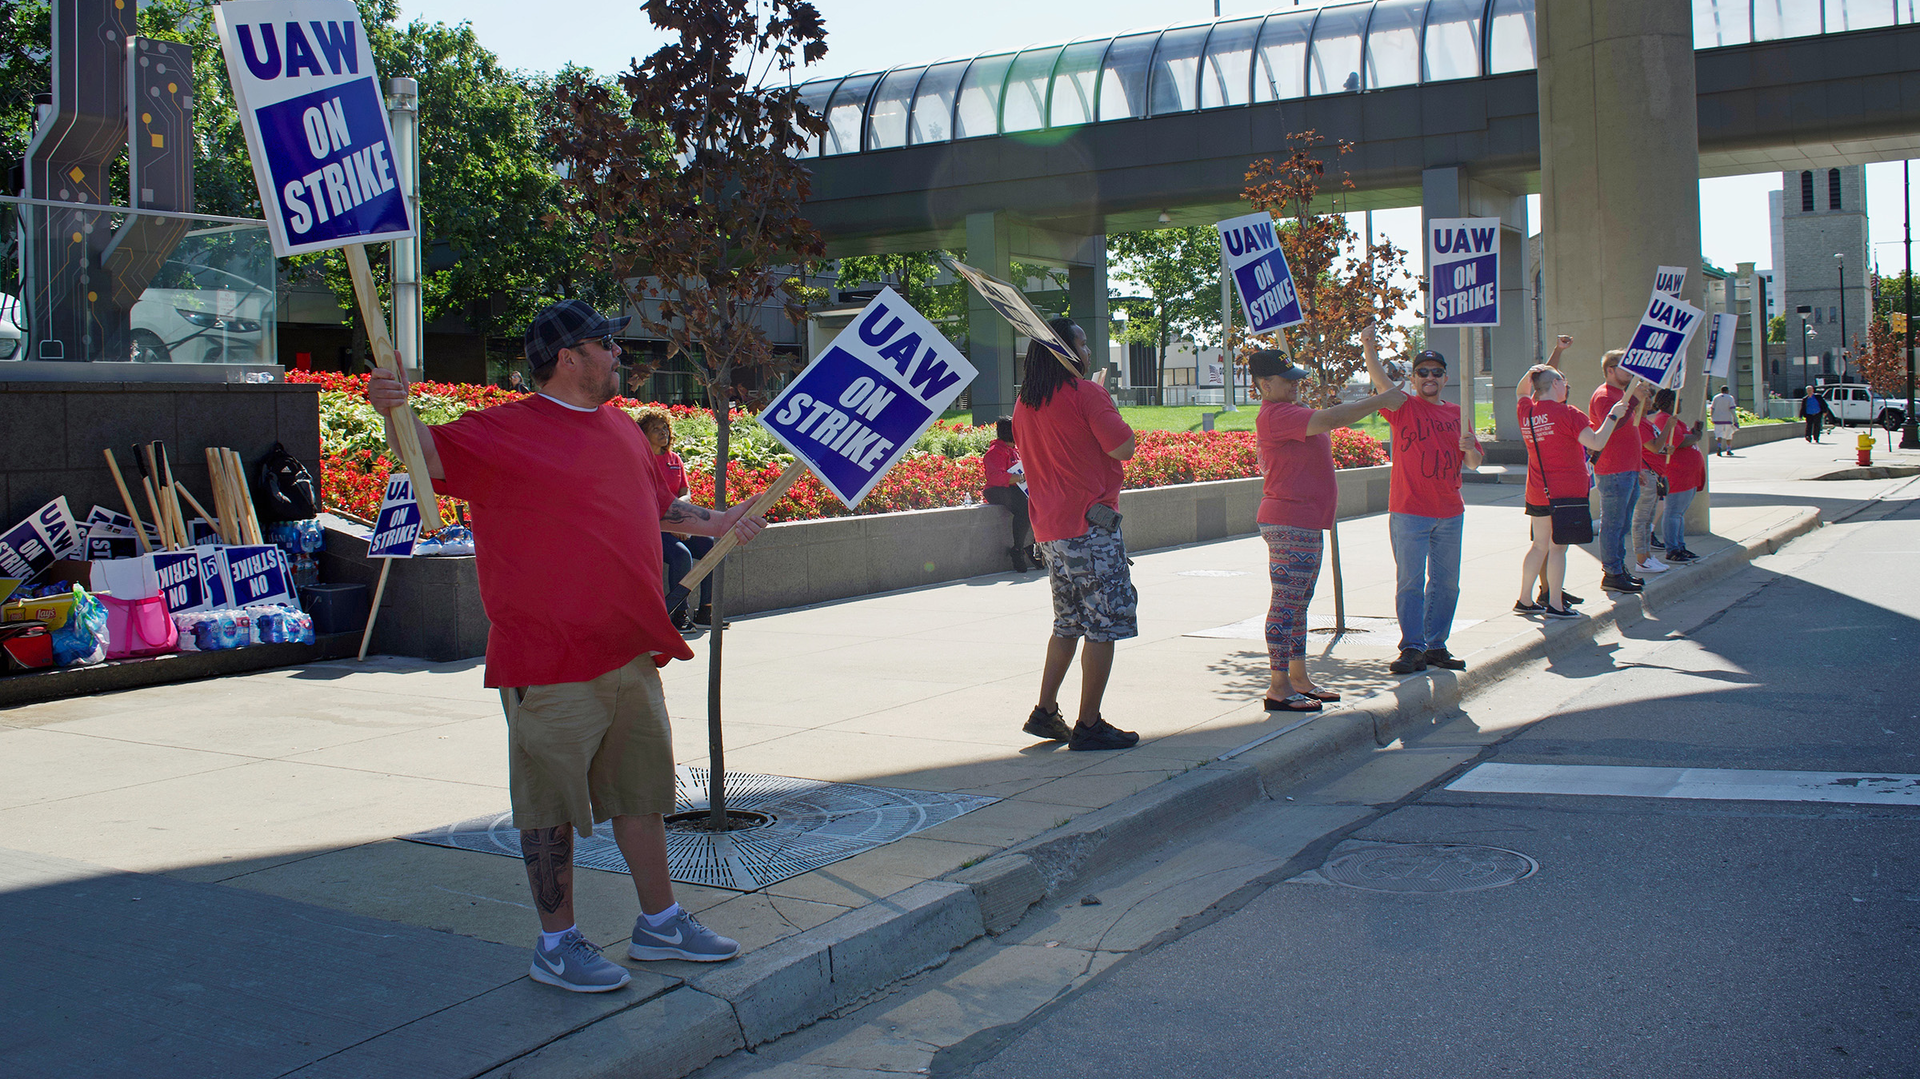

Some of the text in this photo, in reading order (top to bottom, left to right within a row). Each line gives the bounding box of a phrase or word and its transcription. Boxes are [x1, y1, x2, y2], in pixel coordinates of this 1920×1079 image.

[235, 20, 359, 81] UAW
[302, 96, 352, 160] ON
[283, 140, 396, 235] STRIKE
[1223, 221, 1274, 257] UAW
[1434, 227, 1496, 254] UAW
[1253, 259, 1276, 291] ON
[1453, 261, 1477, 290] ON
[1656, 272, 1685, 292] UAW
[1249, 277, 1295, 327] STRIKE
[1435, 282, 1494, 321] STRIKE
[1648, 298, 1694, 332] UAW
[858, 302, 961, 401] UAW
[1645, 331, 1669, 350] ON
[1624, 348, 1673, 370] STRIKE
[838, 376, 897, 422] ON
[775, 392, 895, 473] STRIKE
[39, 502, 74, 555] UAW
[389, 506, 409, 528] ON
[18, 538, 46, 562] ON
[371, 523, 418, 552] STRIKE
[155, 556, 198, 589] STRIK
[230, 549, 278, 582] STRIKE
[168, 583, 188, 609] ON
[248, 574, 269, 598] ON
